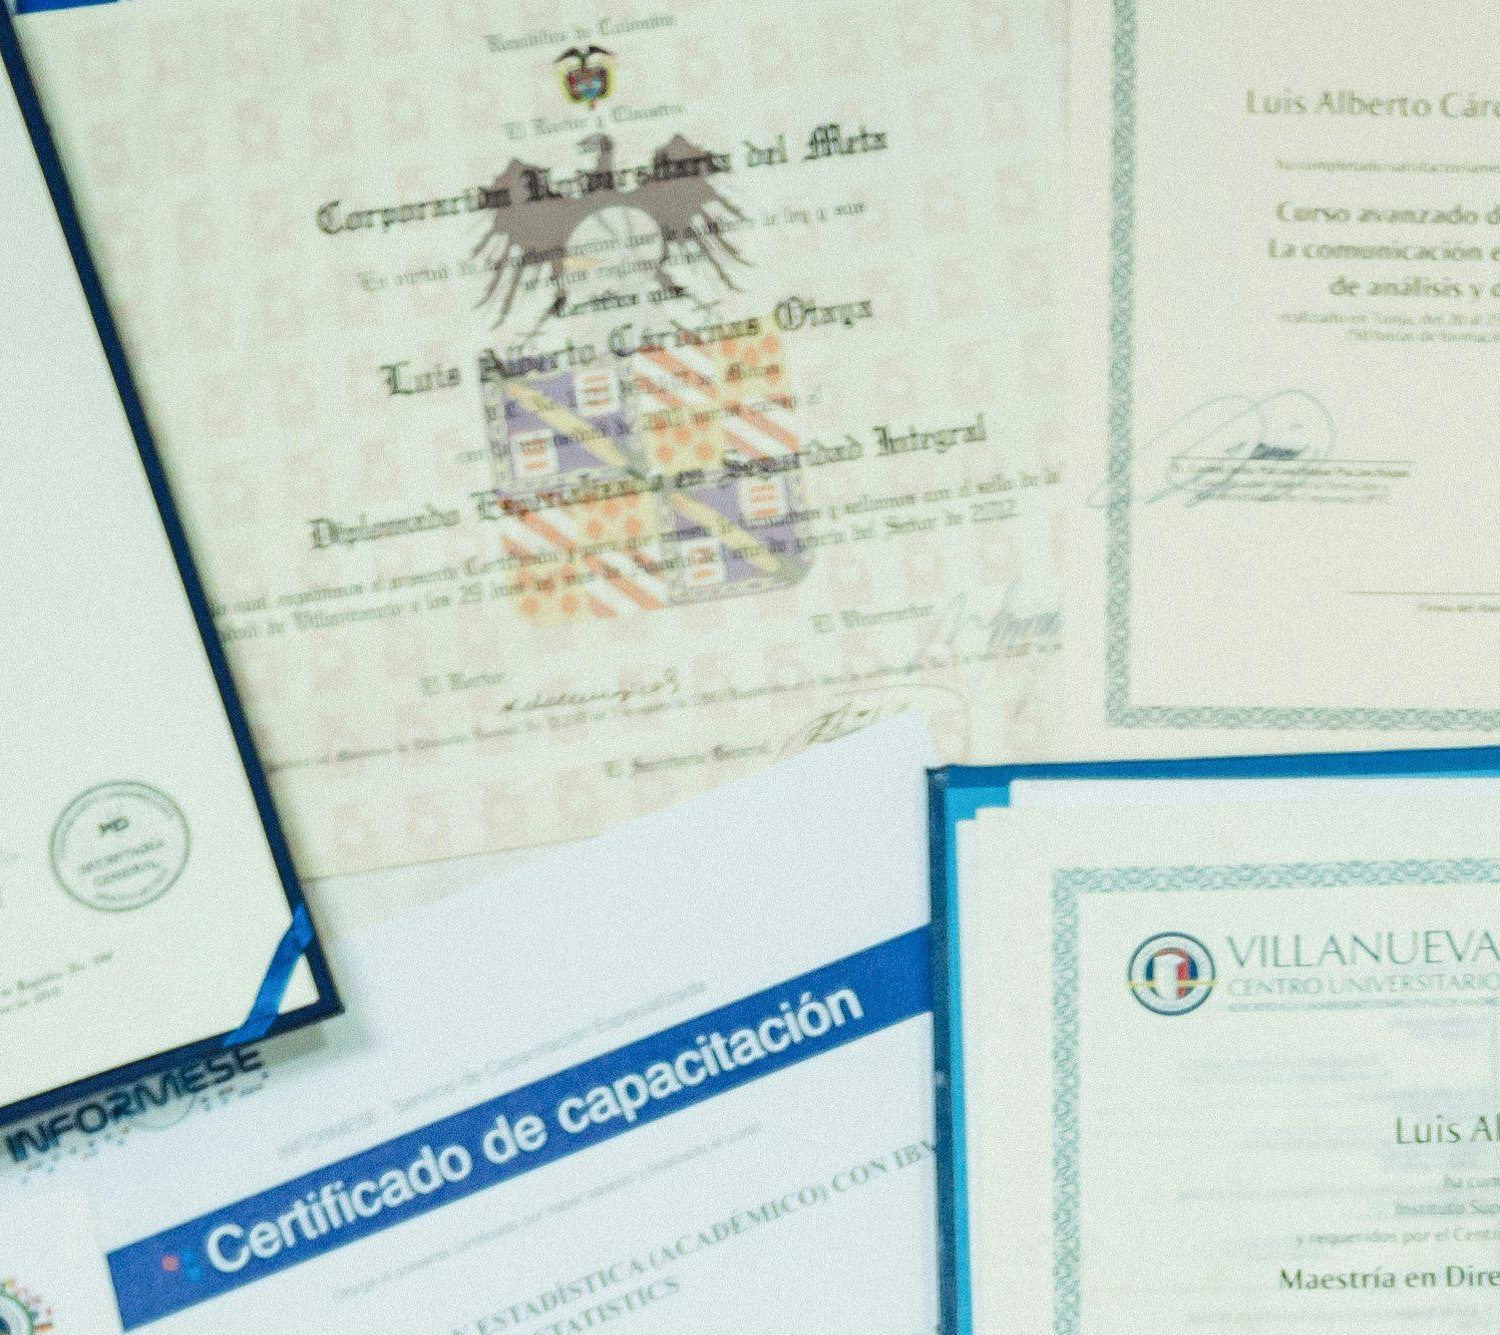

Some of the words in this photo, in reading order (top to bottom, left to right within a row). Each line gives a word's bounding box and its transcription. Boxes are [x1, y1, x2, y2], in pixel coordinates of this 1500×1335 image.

[1227, 929, 1500, 968] VILLANUEVA
[204, 1144, 473, 1275] Certificado
[482, 1108, 547, 1163] de
[555, 981, 865, 1137] capacitación
[1278, 1265, 1396, 1292] Maestría
[1405, 1272, 1436, 1287] en
